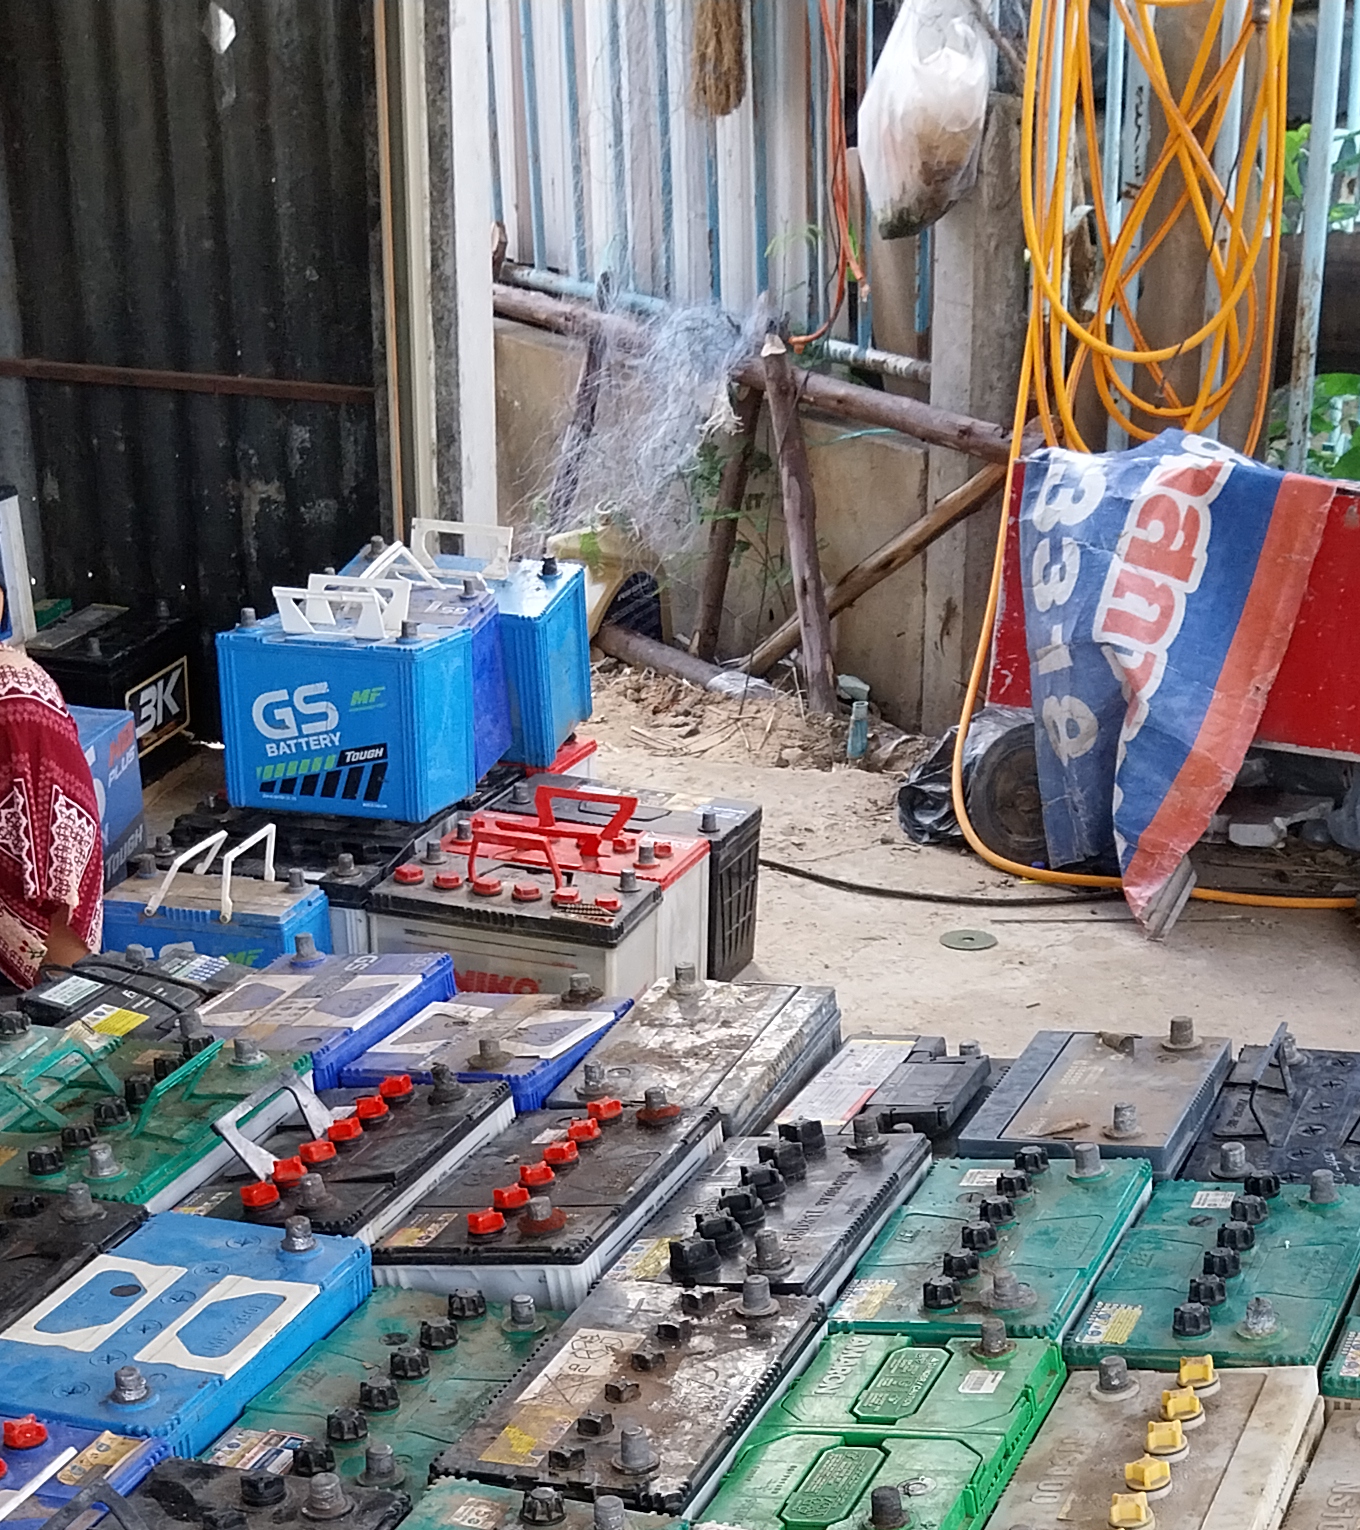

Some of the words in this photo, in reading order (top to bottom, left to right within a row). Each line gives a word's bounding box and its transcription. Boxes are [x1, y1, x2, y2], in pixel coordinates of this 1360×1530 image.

[252, 682, 339, 740] GS
[351, 687, 385, 706] MF
[266, 732, 341, 757] BATTERY
[344, 747, 385, 763] TOUGH
[109, 747, 136, 788] PLUS
[106, 824, 144, 880] TOUGH
